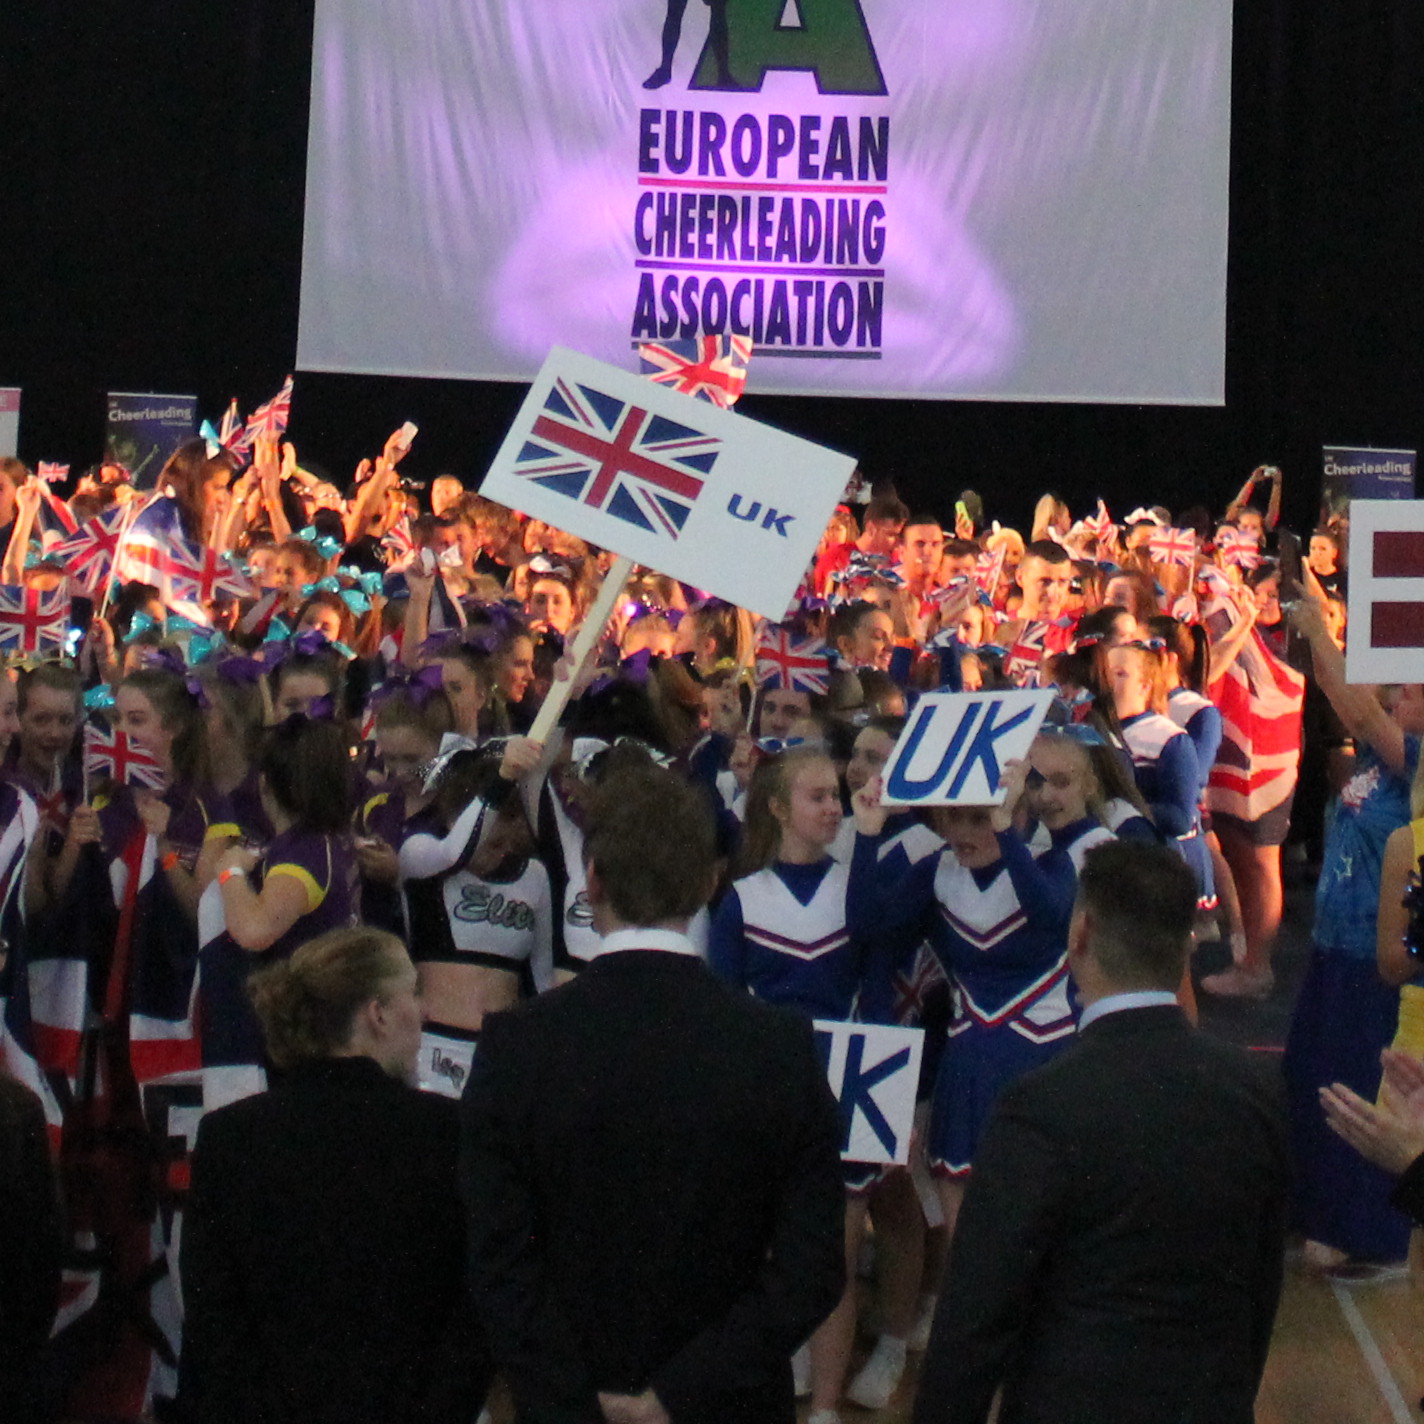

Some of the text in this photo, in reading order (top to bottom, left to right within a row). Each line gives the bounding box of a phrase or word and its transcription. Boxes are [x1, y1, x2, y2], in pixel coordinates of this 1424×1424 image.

[638, 108, 890, 181] EUROPEAN
[634, 191, 887, 265] CHEERLEADING
[631, 272, 885, 347] ASSOCIATION
[1324, 460, 1411, 475] Cheerleading
[727, 493, 797, 538] UK
[887, 700, 1036, 801] UK
[812, 1030, 911, 1161] K
